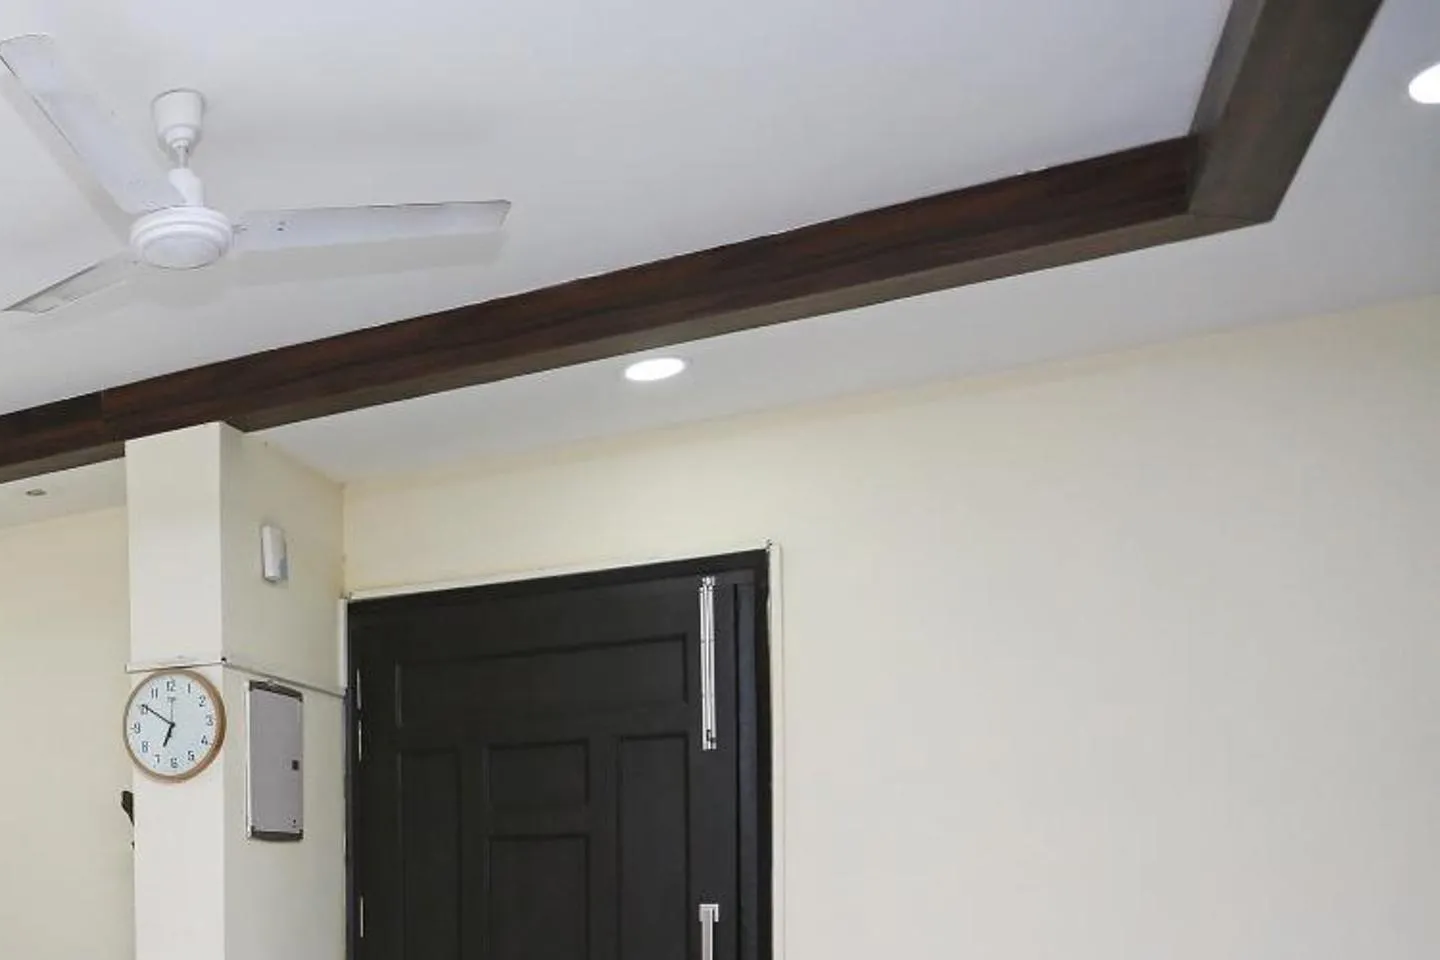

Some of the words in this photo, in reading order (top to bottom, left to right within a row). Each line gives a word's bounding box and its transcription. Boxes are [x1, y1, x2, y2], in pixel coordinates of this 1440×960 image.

[166, 680, 176, 692] 12
[151, 687, 158, 699] 11
[199, 695, 206, 707] 2
[201, 735, 208, 745] 4
[155, 754, 161, 764] 7
[187, 750, 195, 761] 5
